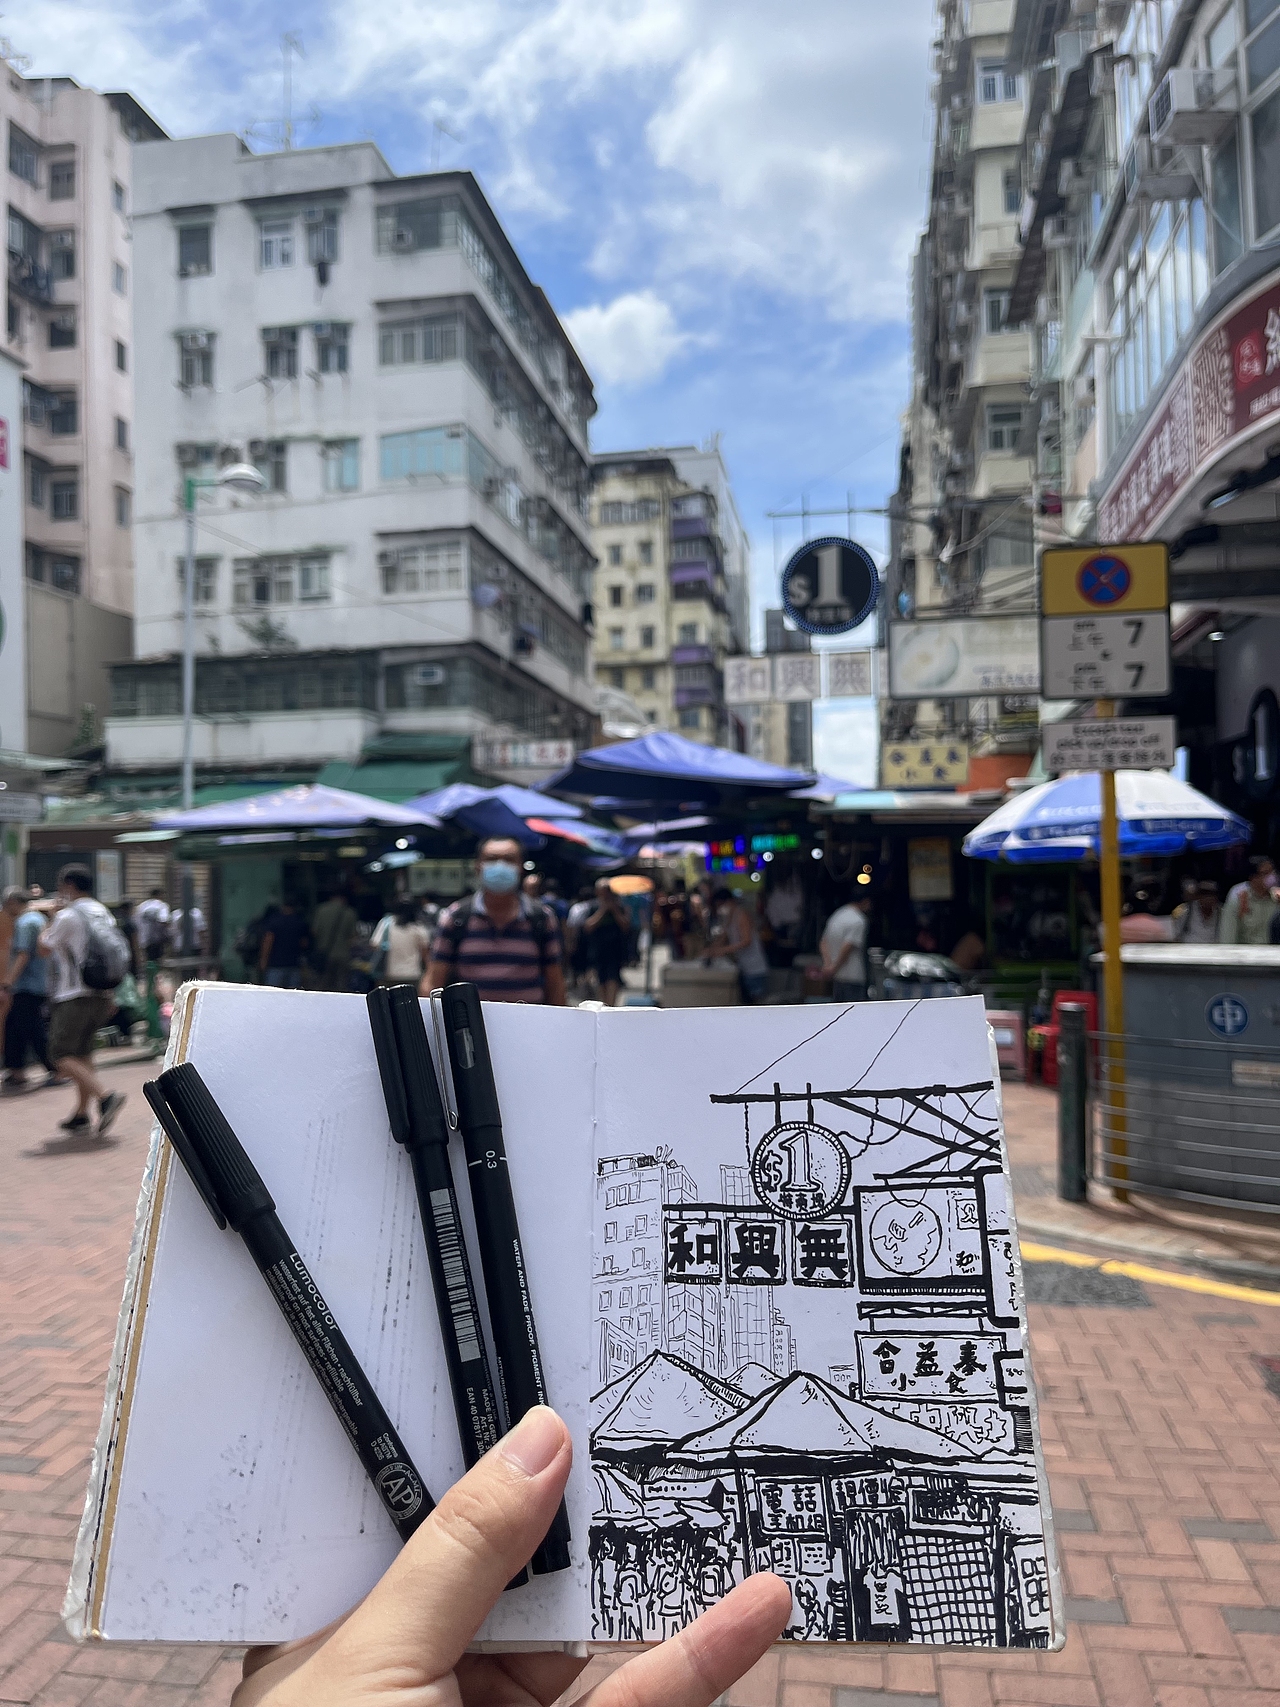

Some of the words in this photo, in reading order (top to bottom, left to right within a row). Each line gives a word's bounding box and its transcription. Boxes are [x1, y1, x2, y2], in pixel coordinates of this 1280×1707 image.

[1123, 618, 1143, 648] 7
[1124, 661, 1145, 690] 7
[485, 1149, 497, 1169] 0.3
[760, 1130, 821, 1192] $1
[512, 1238, 521, 1267] WATER
[288, 1251, 339, 1332] Lumocolor
[517, 1269, 525, 1288] AND
[520, 1289, 529, 1312] FADE
[269, 1263, 296, 1302] waterproof
[291, 1301, 301, 1312] on
[297, 1311, 311, 1330] most
[306, 1328, 326, 1357] surfaces
[323, 1360, 346, 1392] refillable
[277, 1258, 302, 1294] wasserfest
[296, 1291, 309, 1306] auf
[303, 1305, 317, 1320] fast
[310, 1318, 326, 1337] allen
[320, 1335, 340, 1364] Flächen
[336, 1366, 365, 1407] nachfüllbar
[530, 1349, 542, 1388] PIGMENT
[466, 1387, 475, 1403] EAN
[481, 1388, 492, 1412] MADE
[469, 1404, 477, 1414] 40
[486, 1413, 493, 1422] IN
[471, 1415, 482, 1438] 07817
[479, 1415, 488, 1430] Art.
[482, 1431, 490, 1443] Nr.
[379, 1470, 417, 1511] AP
[761, 1484, 817, 1514] 電話
